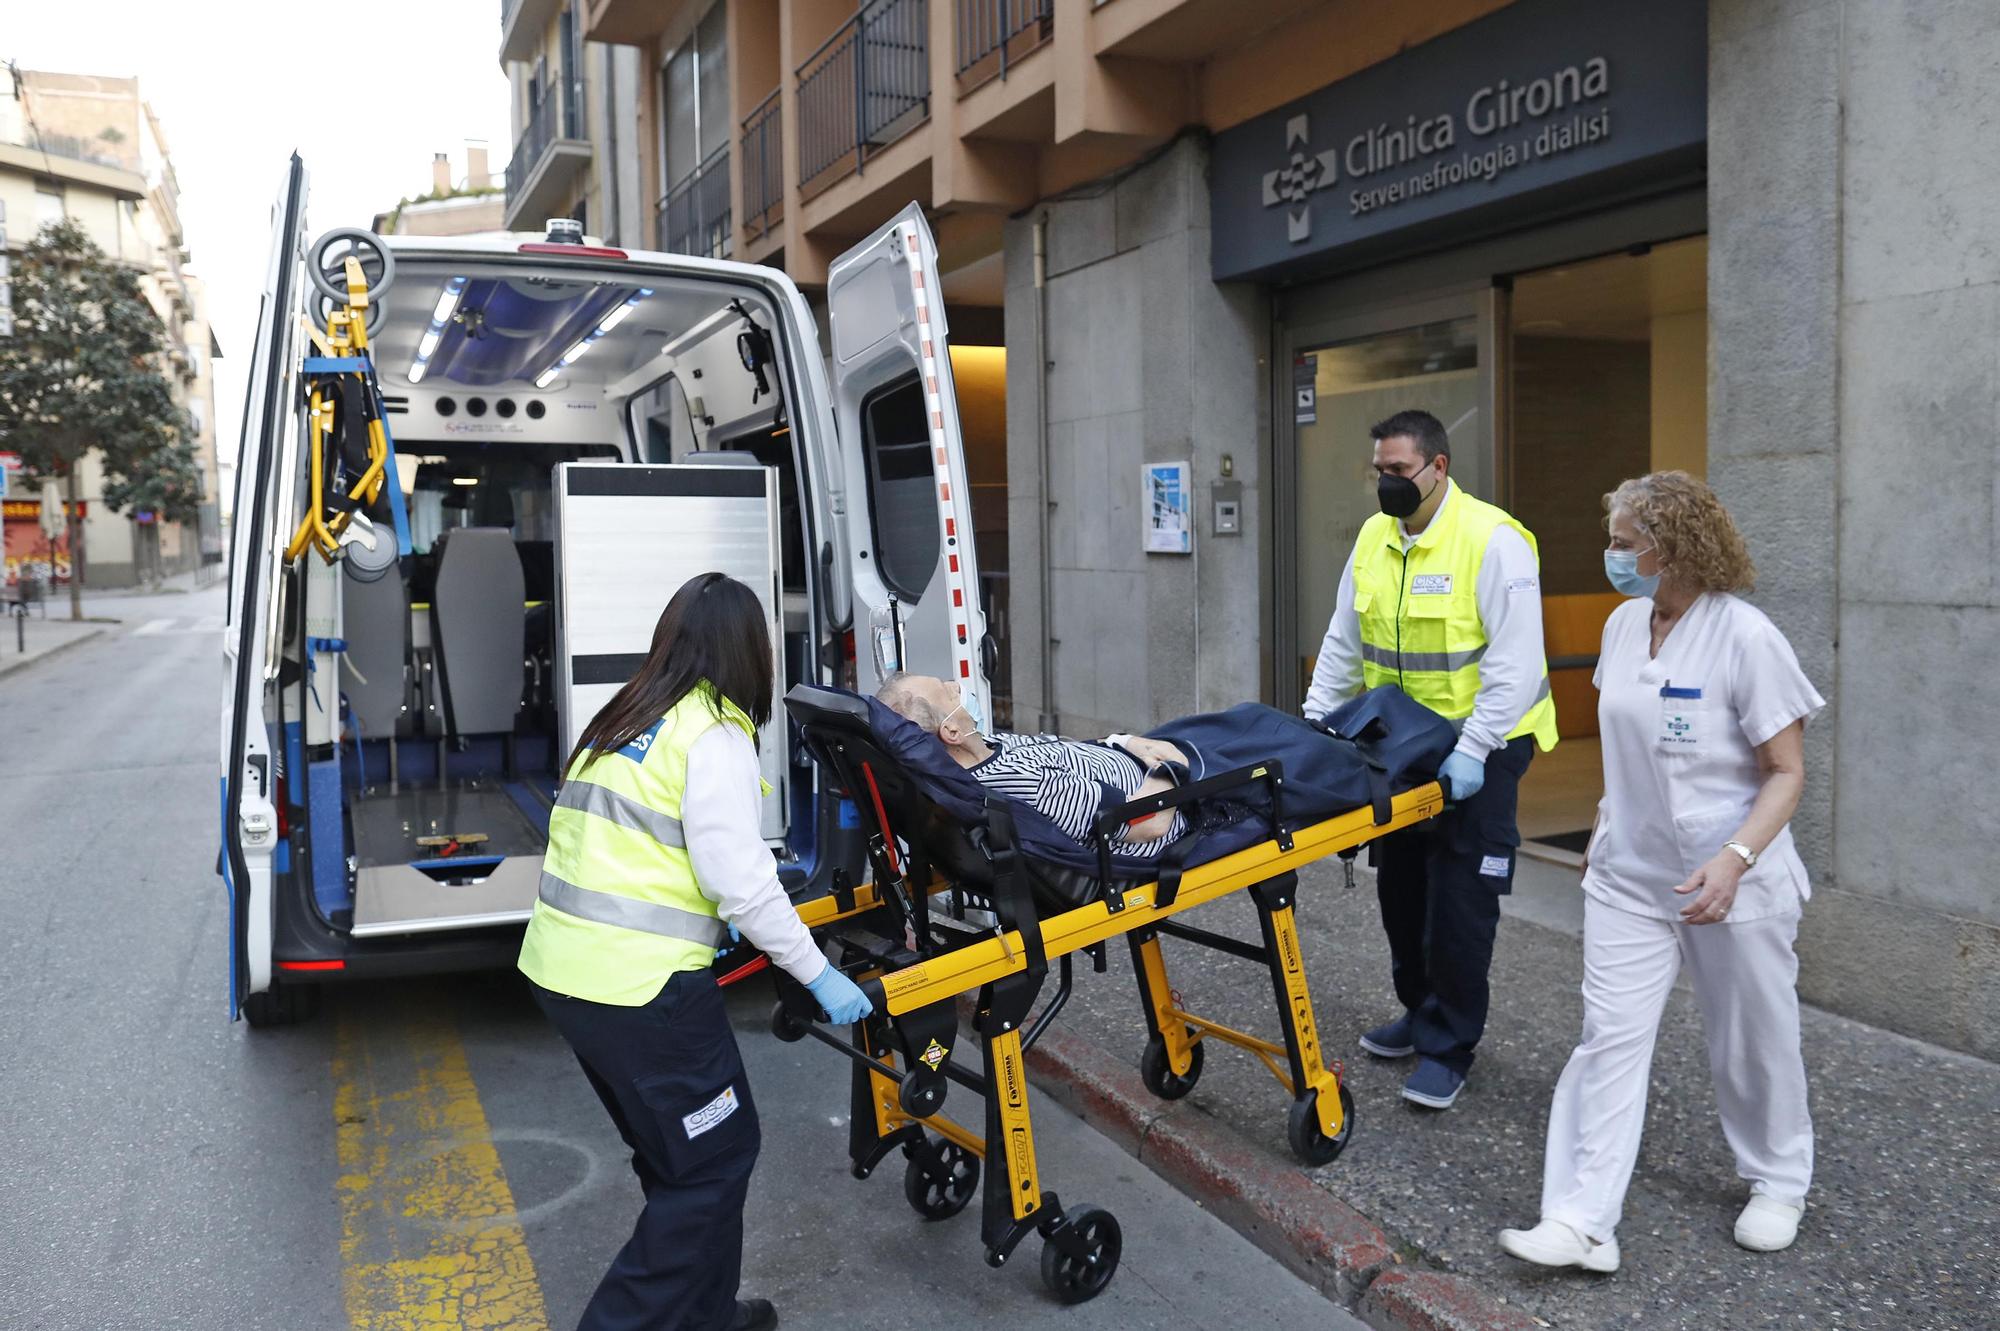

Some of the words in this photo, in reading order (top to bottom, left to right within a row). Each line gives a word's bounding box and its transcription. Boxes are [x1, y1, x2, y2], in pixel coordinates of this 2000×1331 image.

[1345, 114, 1454, 177] Clínica
[1466, 56, 1608, 135] Girona
[1350, 182, 1405, 215] Servei
[1409, 143, 1517, 196] nefrologia
[1535, 107, 1608, 157] dialisi
